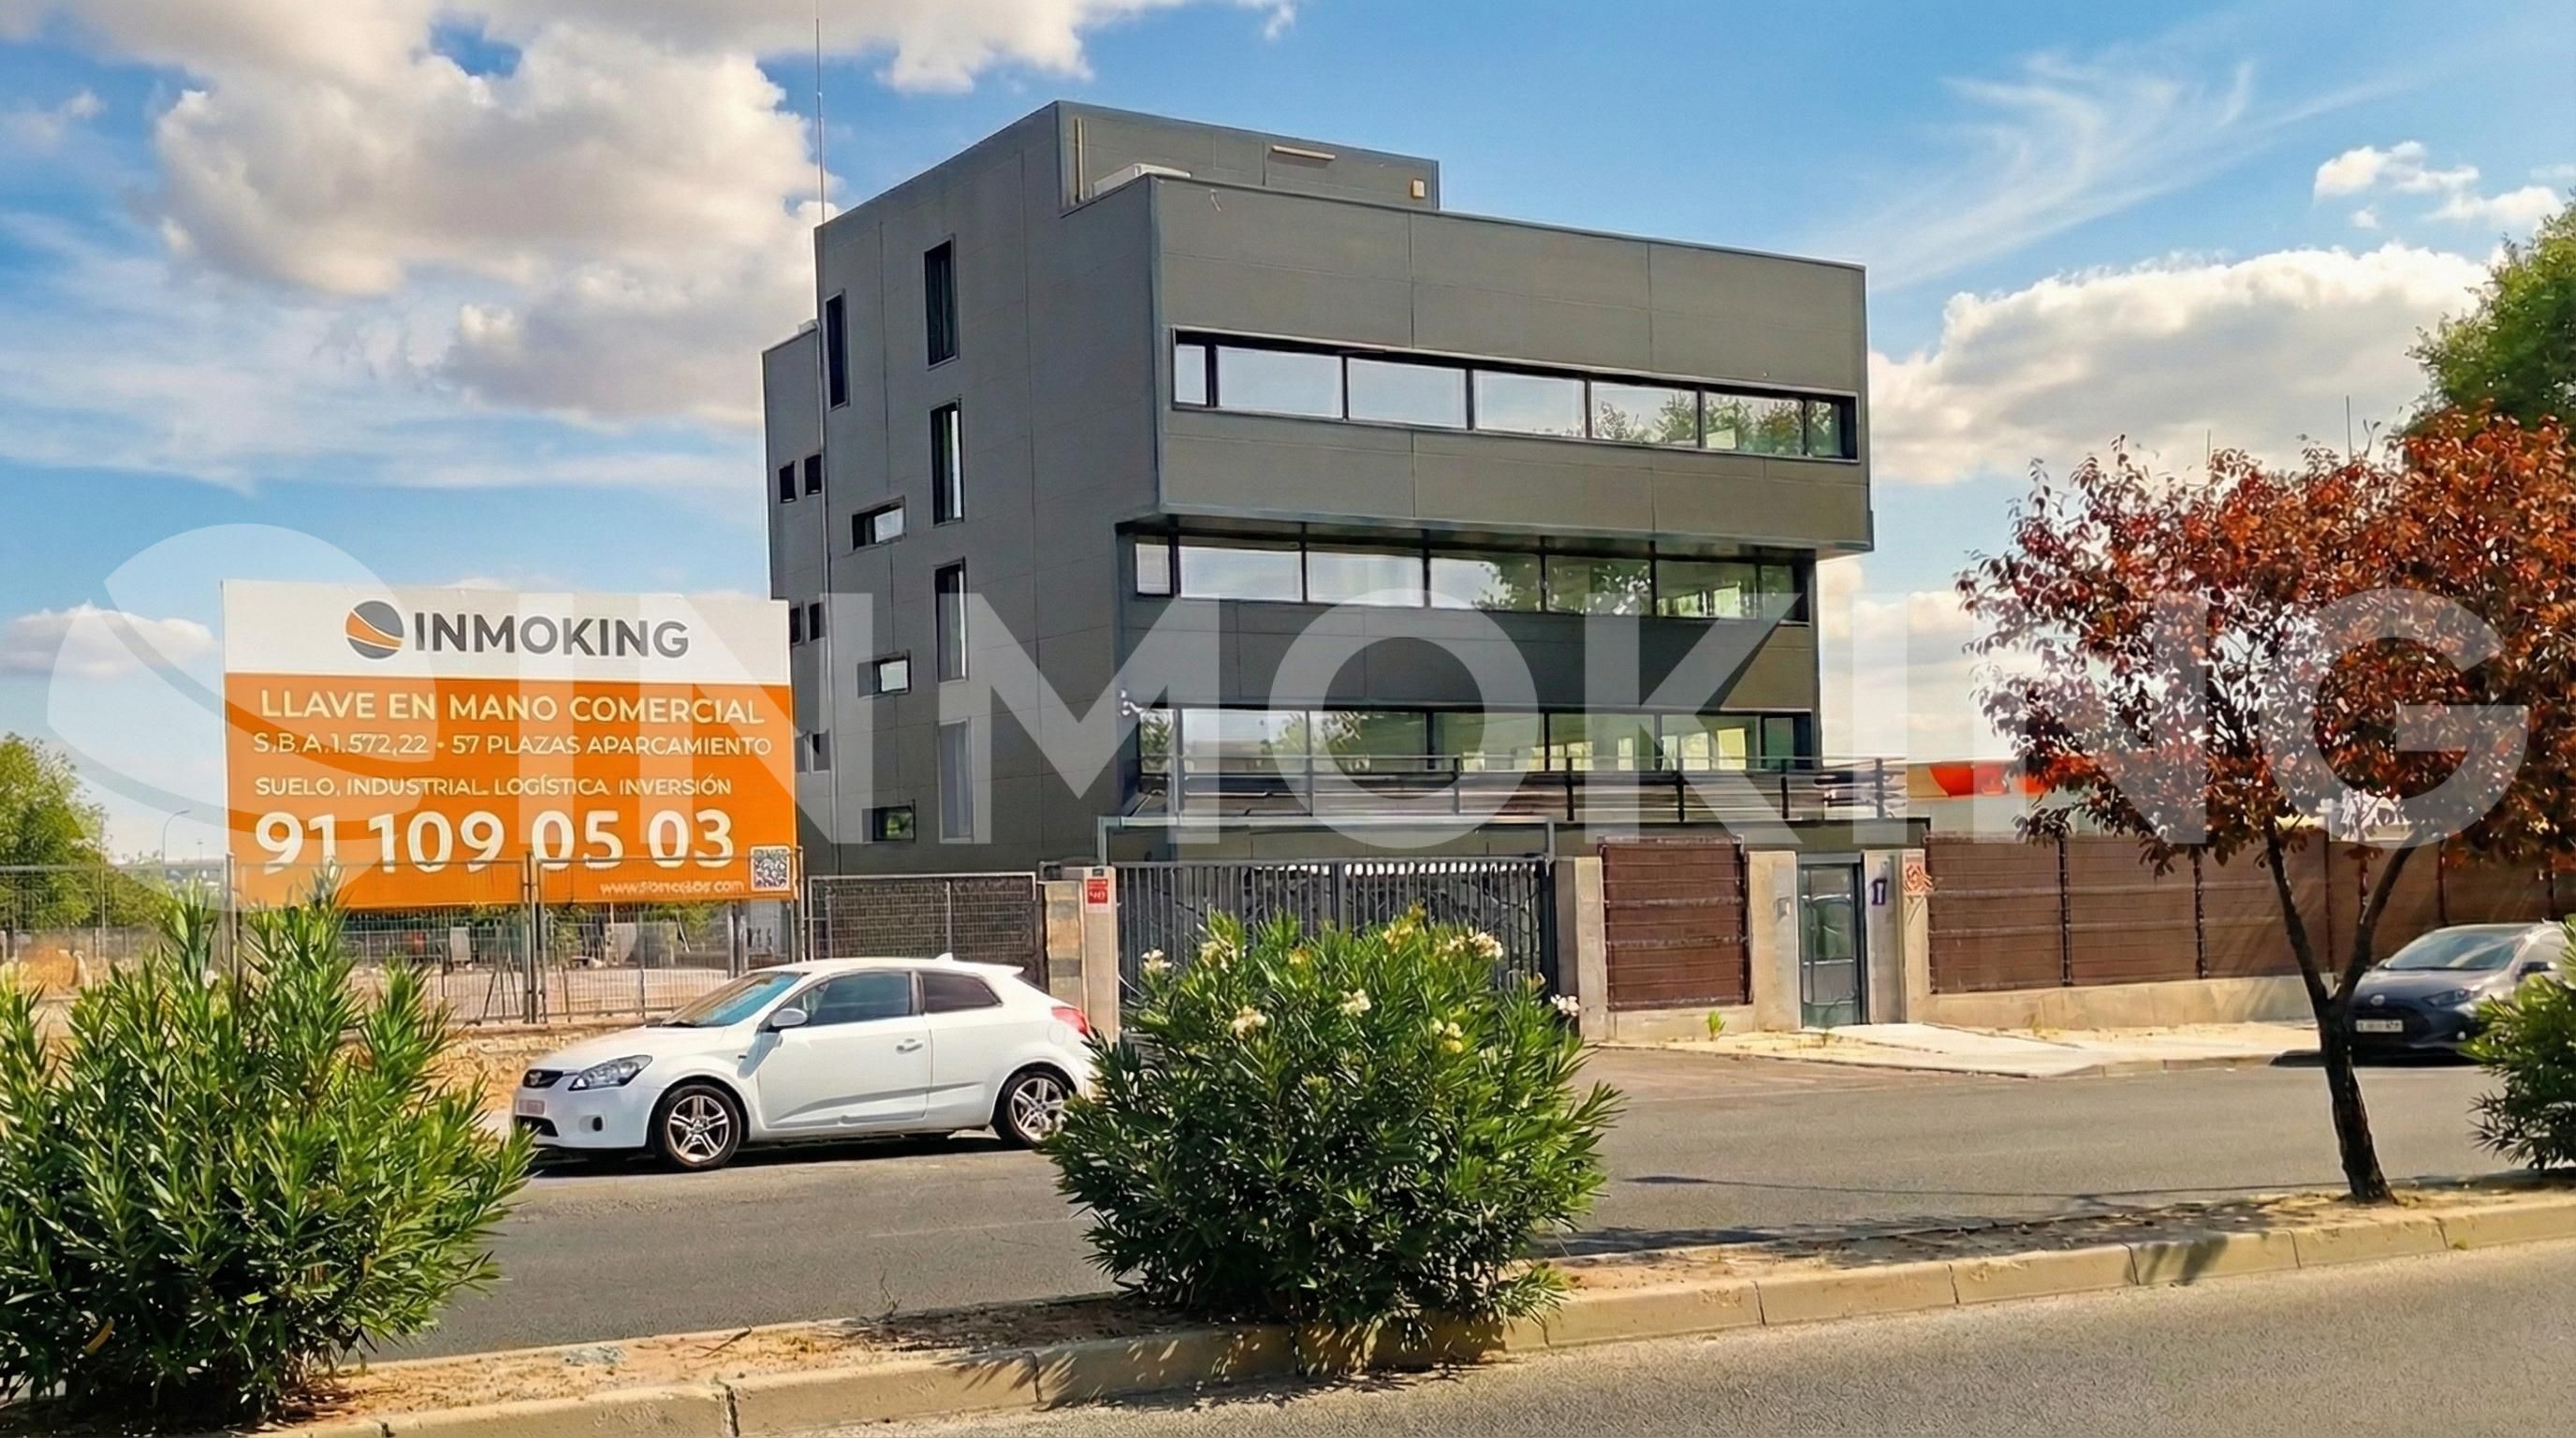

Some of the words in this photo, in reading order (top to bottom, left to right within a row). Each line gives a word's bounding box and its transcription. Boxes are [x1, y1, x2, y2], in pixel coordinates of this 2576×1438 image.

[414, 611, 690, 659] INMOKING
[260, 689, 376, 719] LLAVE
[388, 693, 436, 720] EN
[449, 694, 559, 722] MANO
[569, 696, 766, 726] COMERCIAL
[451, 735, 479, 755] 57
[488, 735, 580, 755] PLAZAS
[587, 736, 772, 756] APARCAMIENTO
[255, 777, 342, 797] SUELO,
[619, 773, 732, 795] INVERSIÓN
[255, 811, 336, 875] 91
[368, 811, 505, 874] 109
[531, 810, 624, 871] 05
[648, 809, 735, 869] 03
